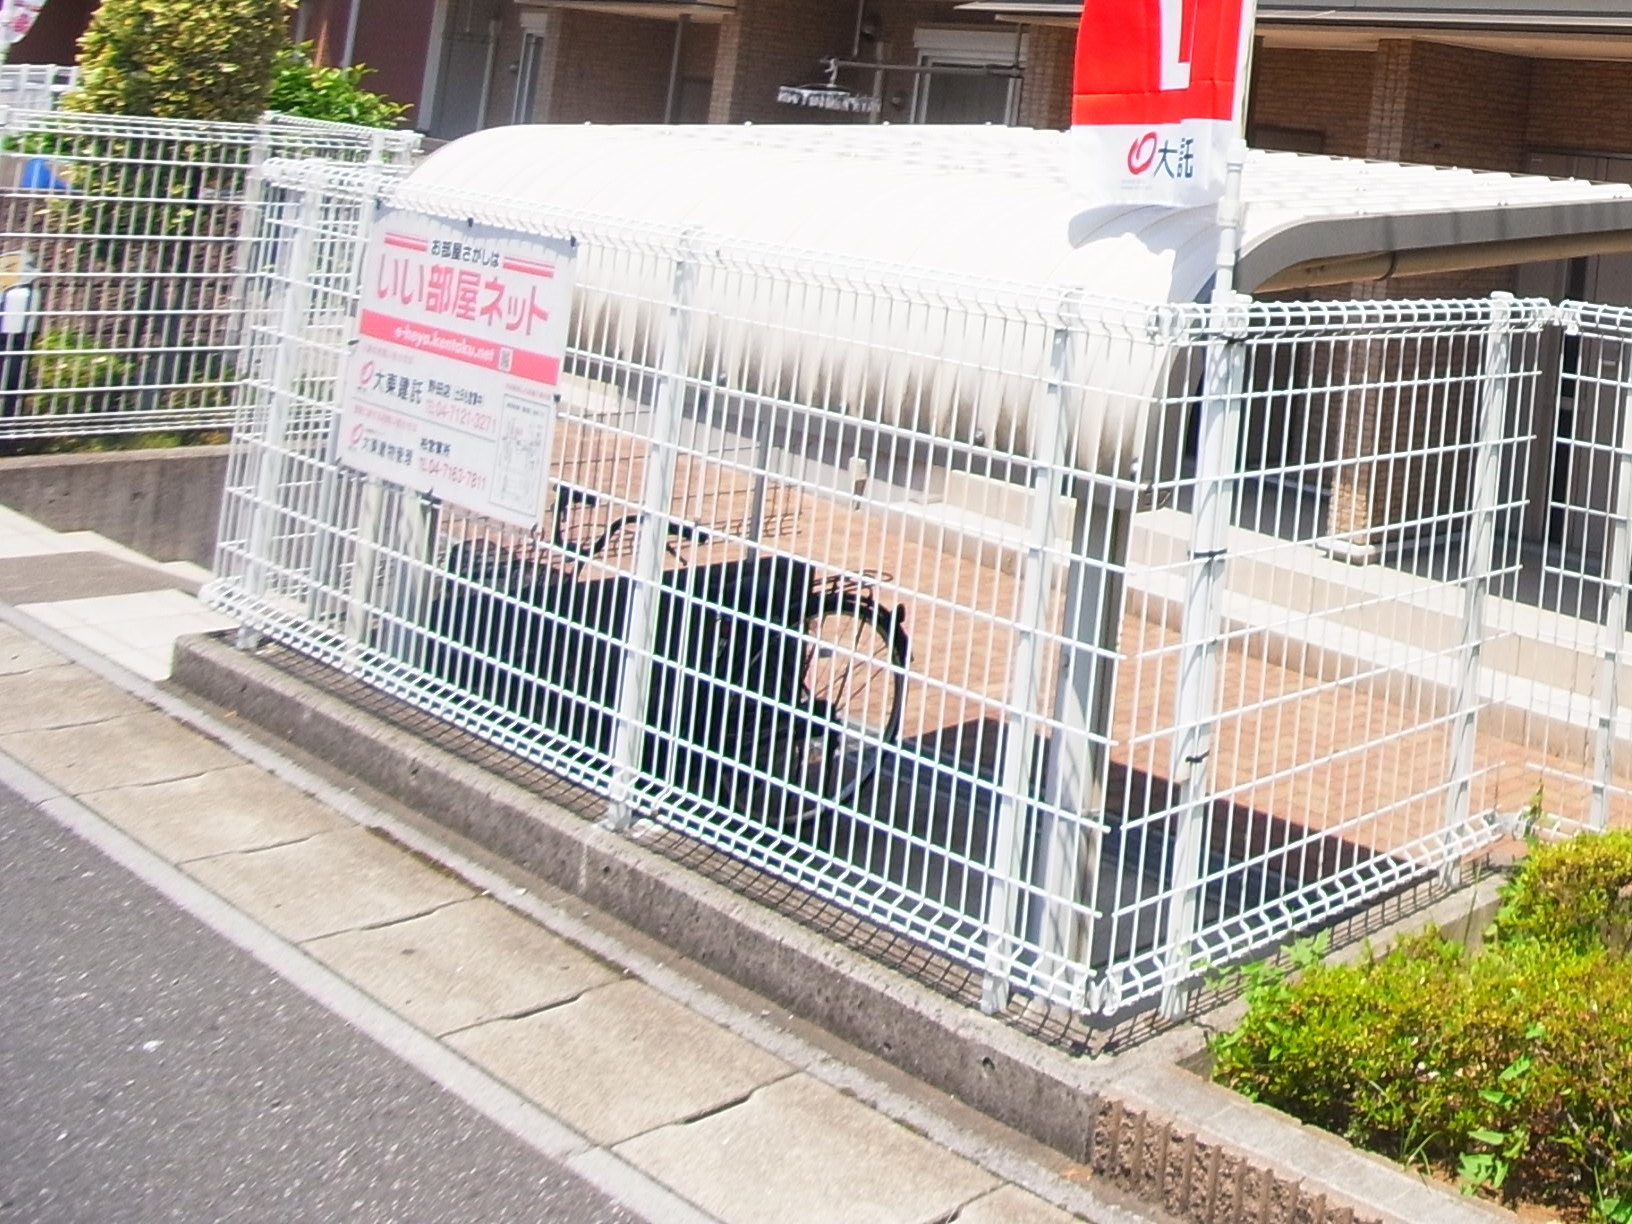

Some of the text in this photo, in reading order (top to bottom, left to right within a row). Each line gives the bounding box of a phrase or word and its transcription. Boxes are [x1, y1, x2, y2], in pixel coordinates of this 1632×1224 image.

[431, 239, 500, 269] お部屋さがしは
[377, 253, 550, 336] いい部屋ネット
